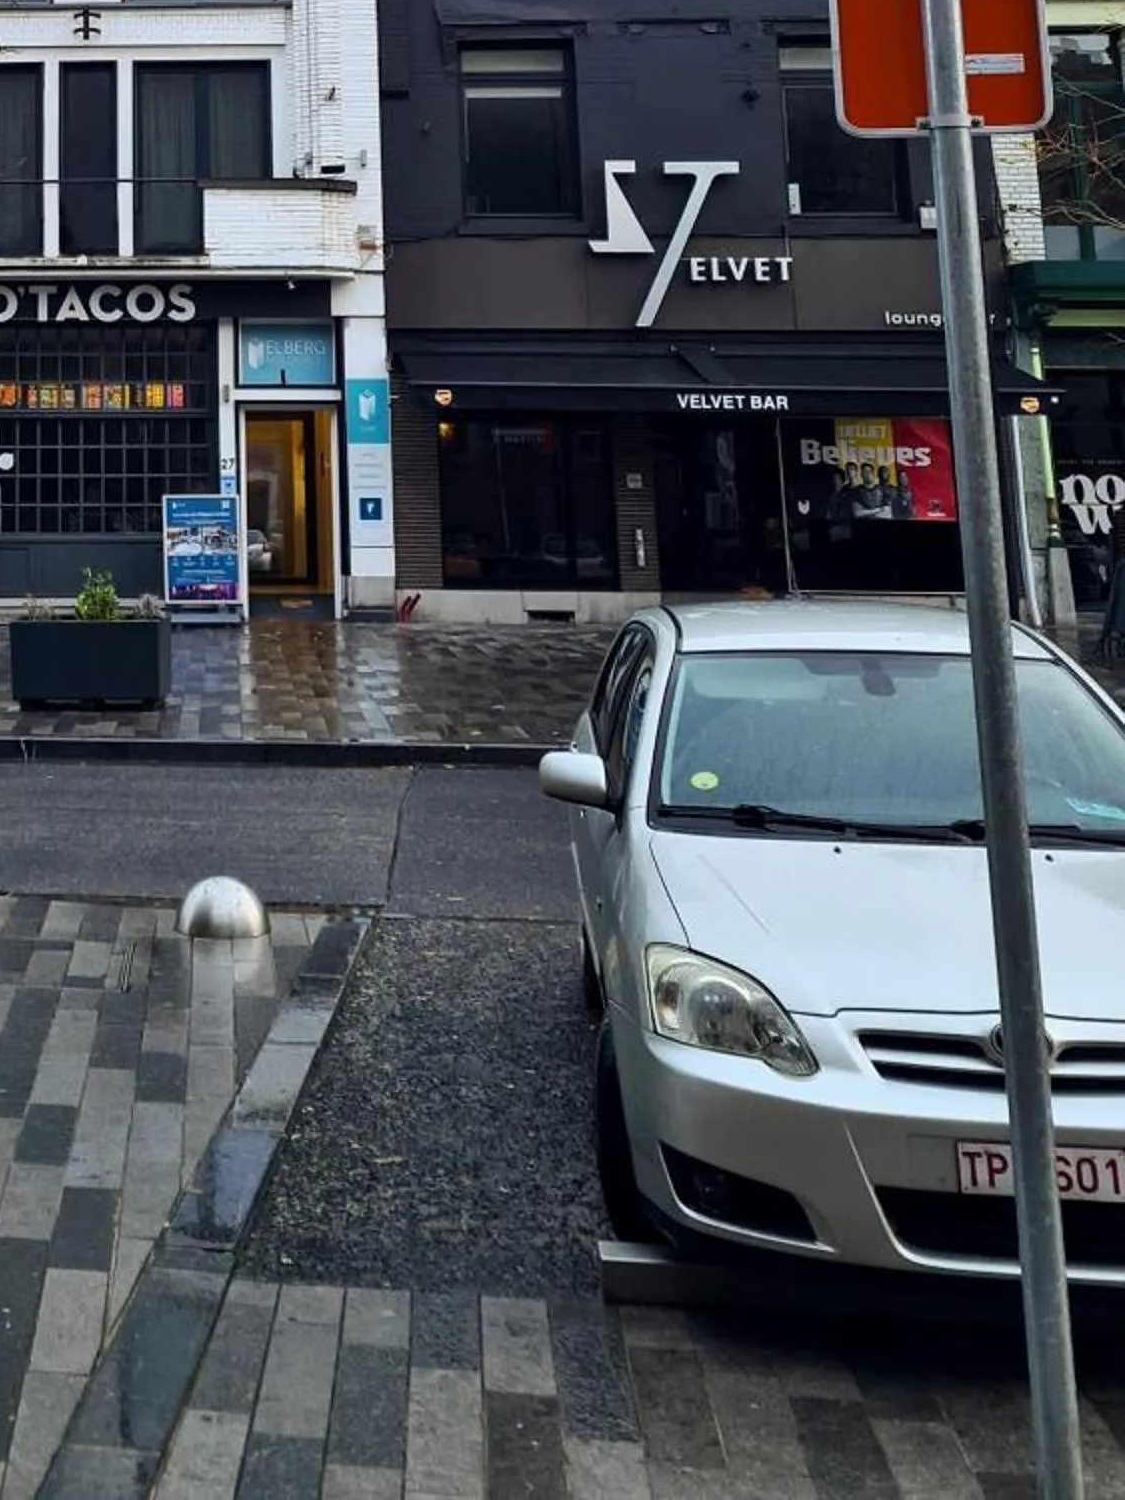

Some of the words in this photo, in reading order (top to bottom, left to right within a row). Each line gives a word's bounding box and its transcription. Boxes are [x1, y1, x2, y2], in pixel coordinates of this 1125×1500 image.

[884, 310, 946, 327] loung
[677, 394, 745, 409] VELVET
[750, 396, 789, 410] BAR
[800, 438, 932, 467] Believes
[962, 1151, 1121, 1195] TP601
